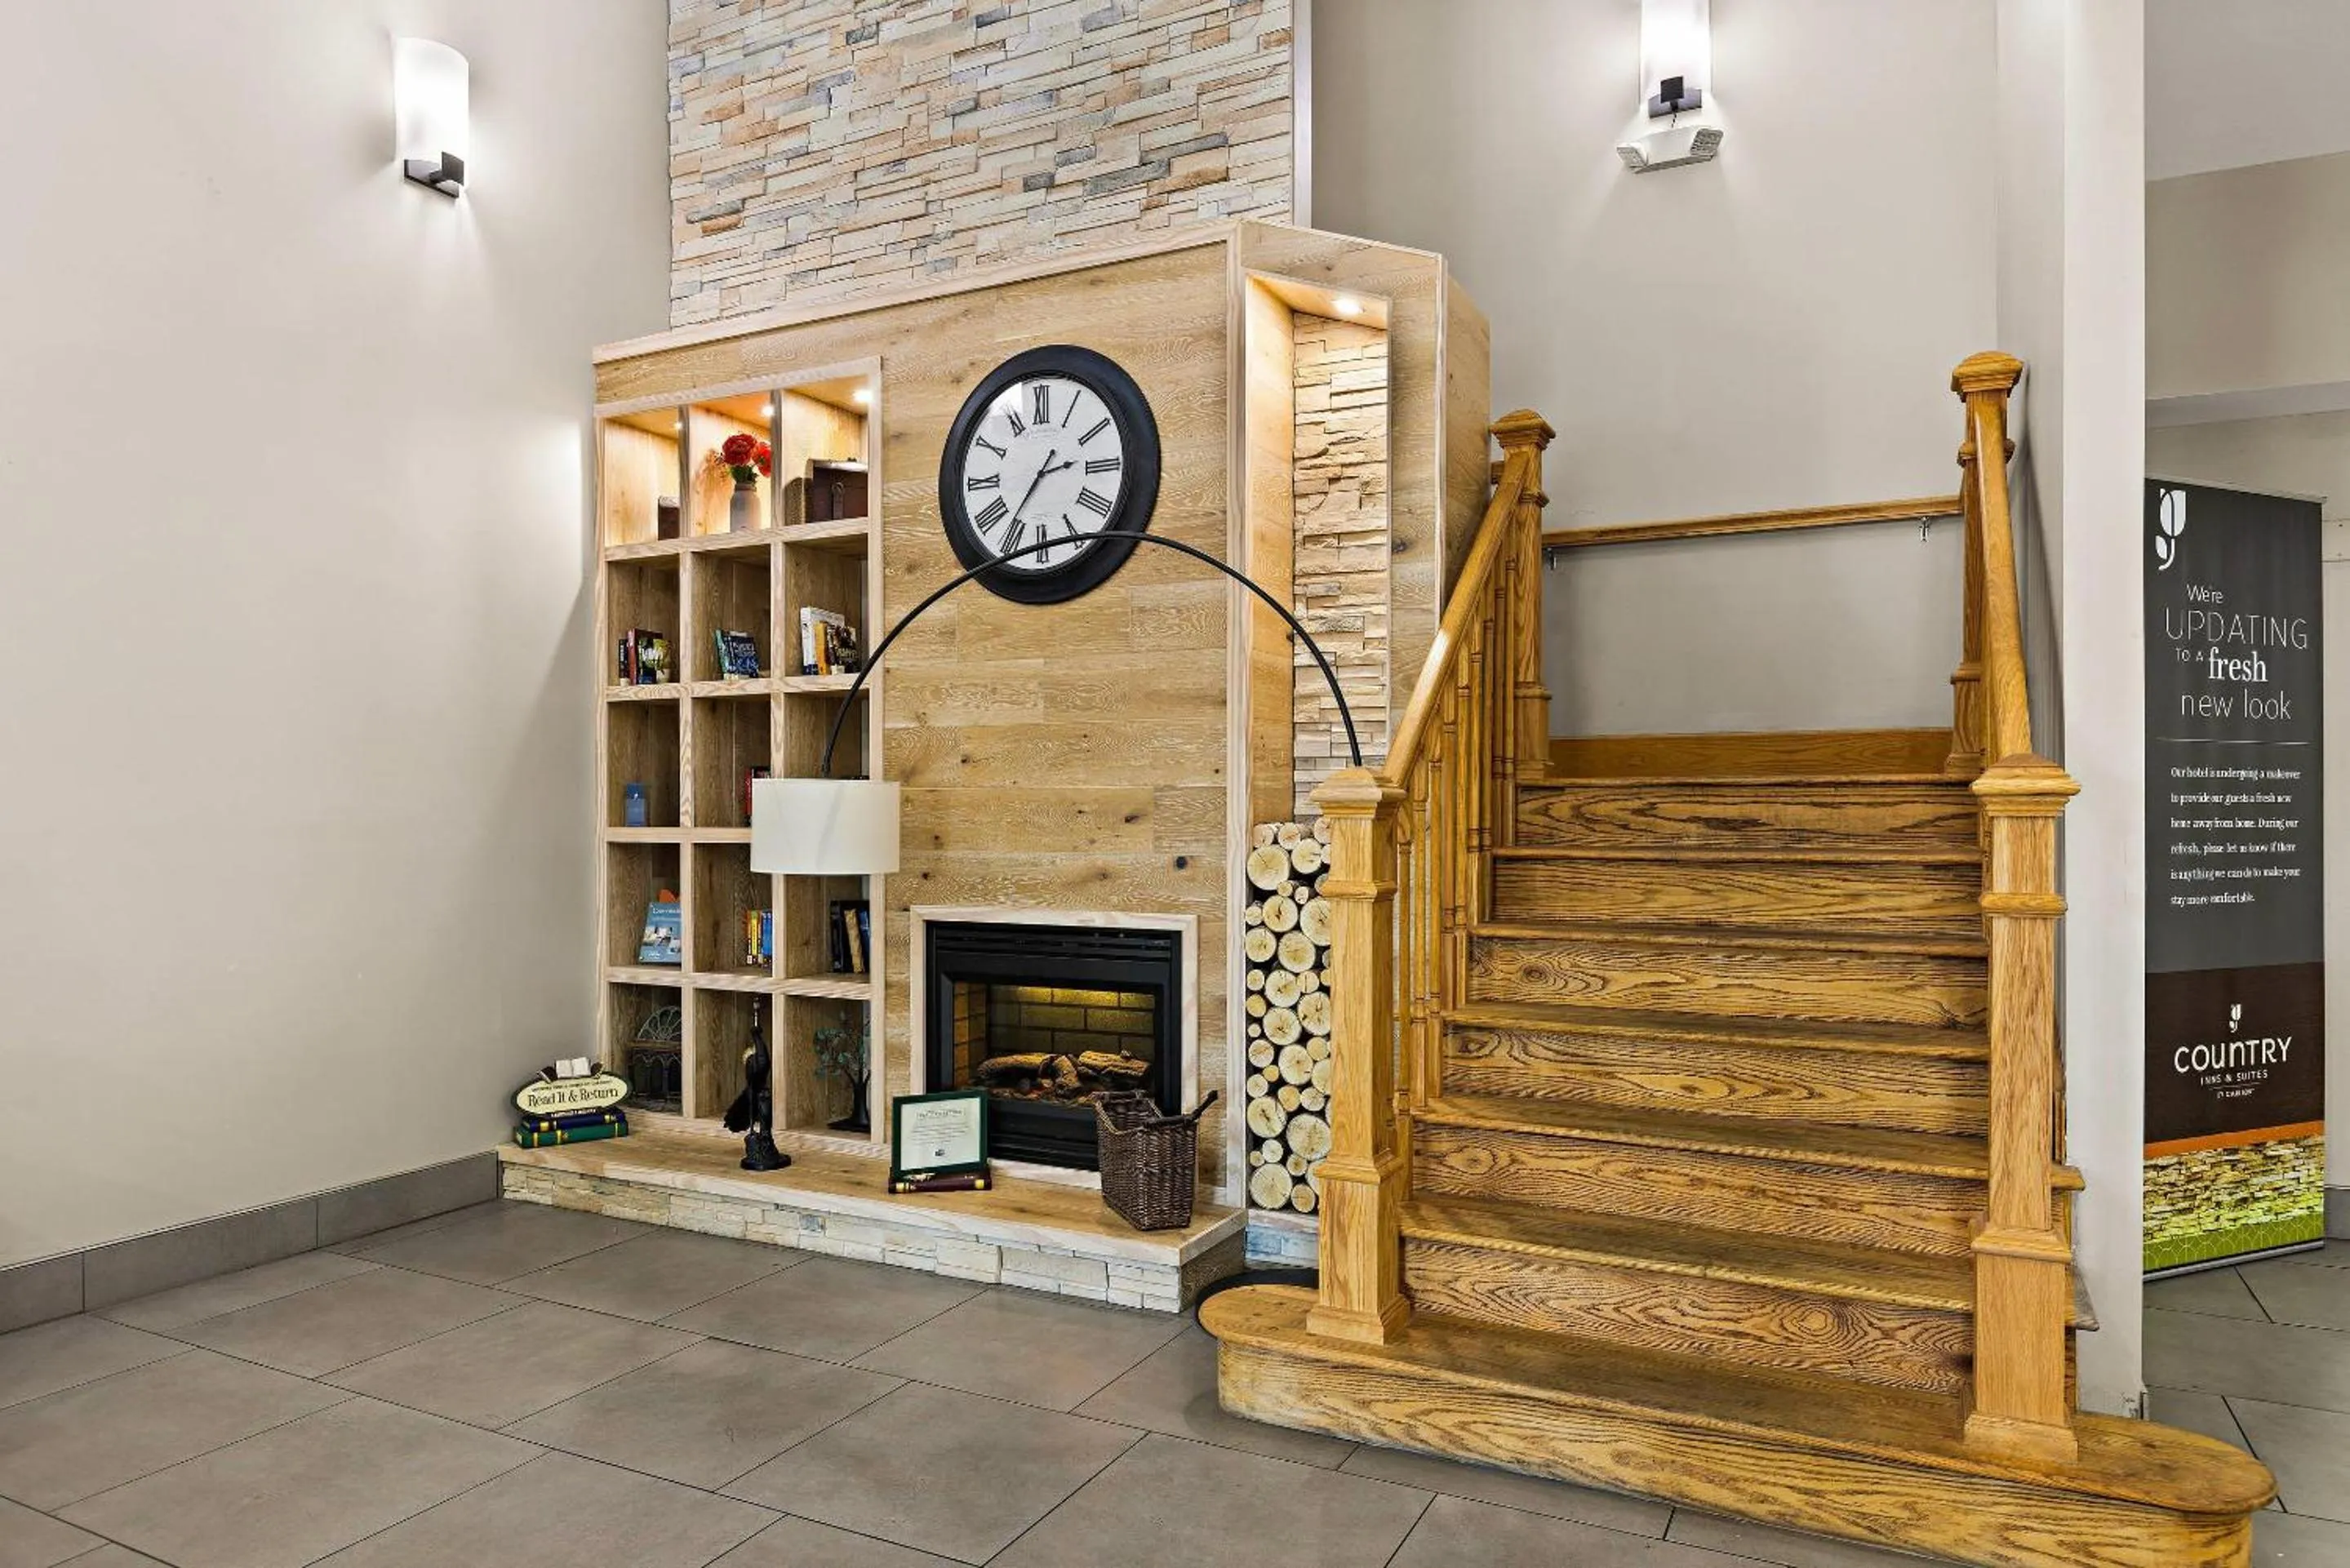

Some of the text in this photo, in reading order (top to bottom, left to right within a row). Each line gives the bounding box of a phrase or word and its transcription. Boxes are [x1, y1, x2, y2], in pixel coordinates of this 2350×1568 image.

[2166, 606, 2308, 651] UPDATING
[2208, 646, 2268, 682] fresh
[2181, 687, 2291, 720] new look
[2237, 1069, 2268, 1082] SUITES
[527, 1093, 556, 1107] Read
[568, 1090, 578, 1103] &
[580, 1087, 619, 1101] Return
